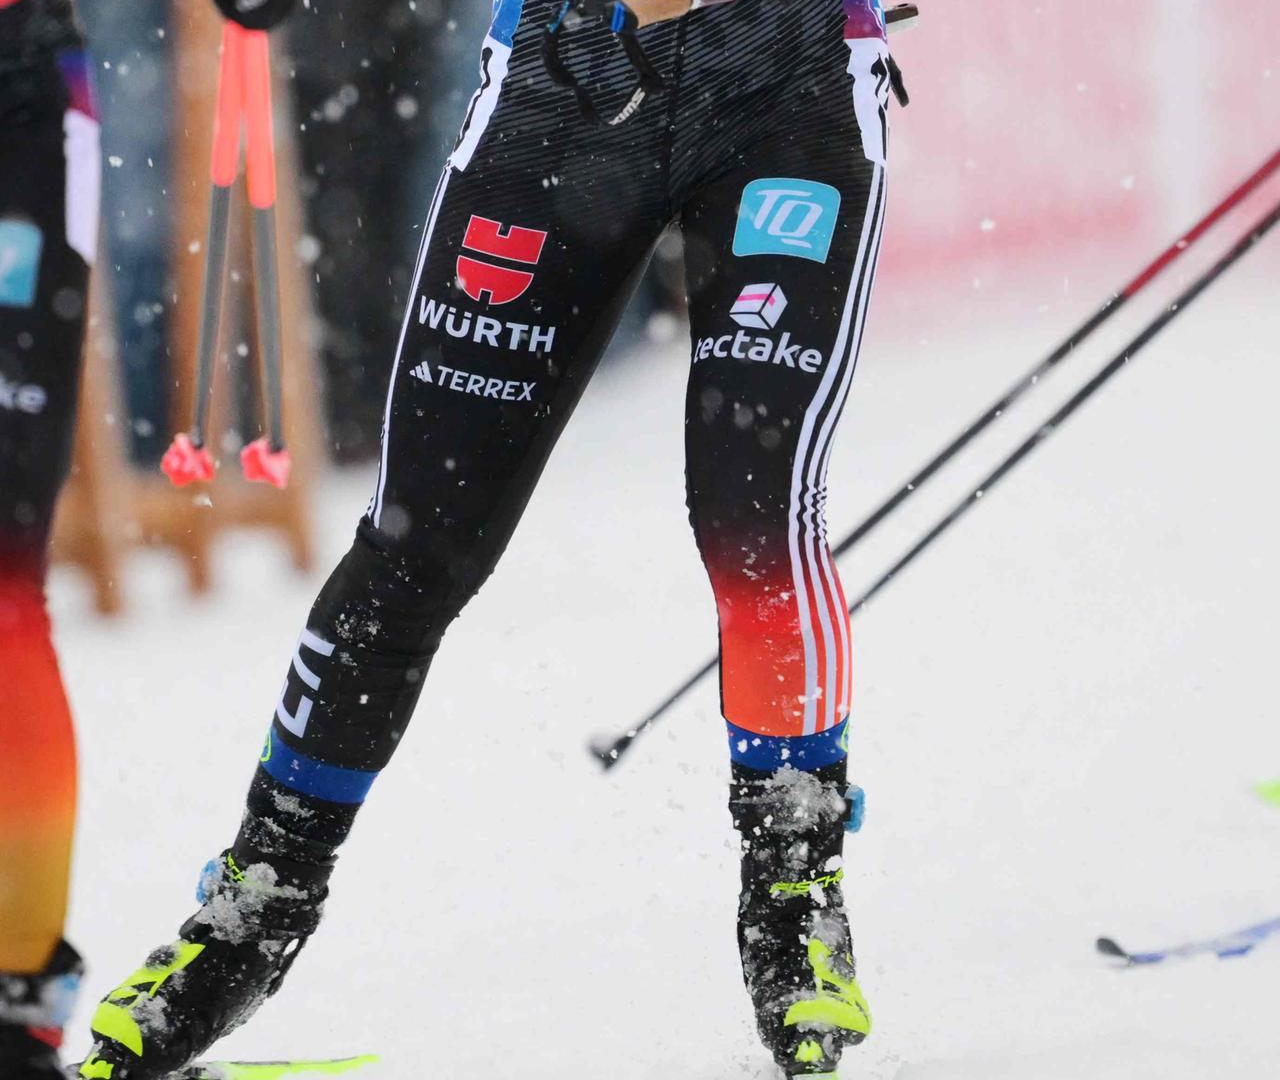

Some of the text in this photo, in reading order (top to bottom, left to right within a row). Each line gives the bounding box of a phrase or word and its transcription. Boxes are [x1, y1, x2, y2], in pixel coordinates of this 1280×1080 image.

[755, 188, 824, 248] TQ
[418, 296, 556, 353] WÜRTH
[693, 331, 823, 373] tectake
[437, 365, 536, 401] TERREX
